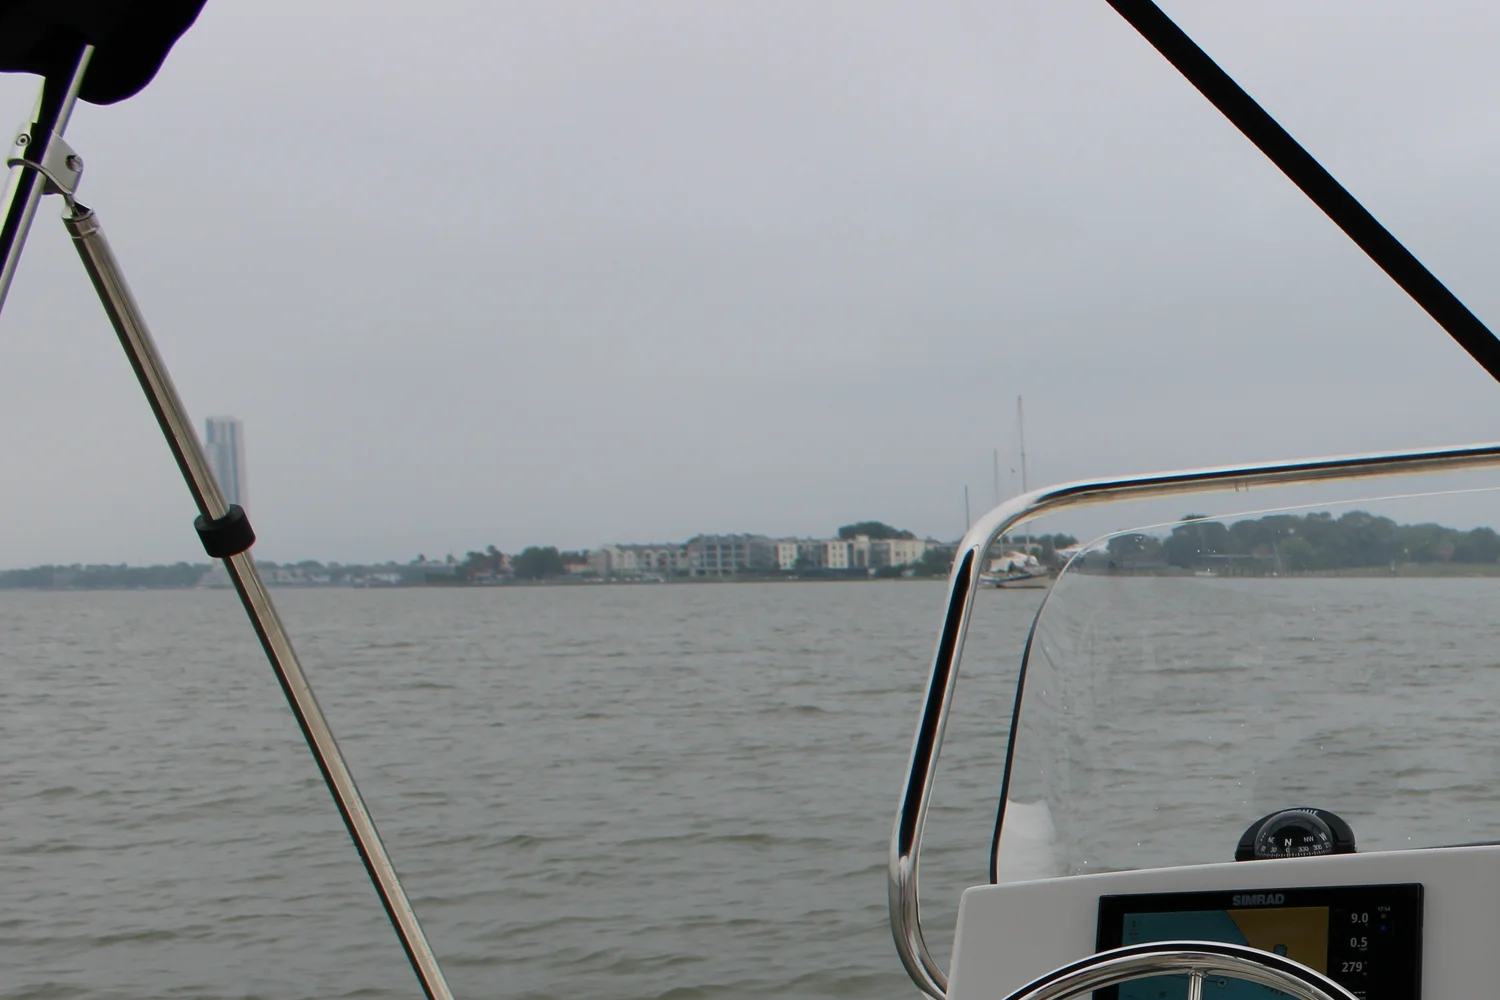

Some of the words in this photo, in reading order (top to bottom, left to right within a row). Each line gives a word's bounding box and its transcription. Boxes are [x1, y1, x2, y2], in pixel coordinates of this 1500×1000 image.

[1284, 838, 1292, 846] N
[1232, 894, 1285, 906] SIMRAD
[1351, 913, 1368, 923] 9.0
[1350, 937, 1368, 948] 0.5
